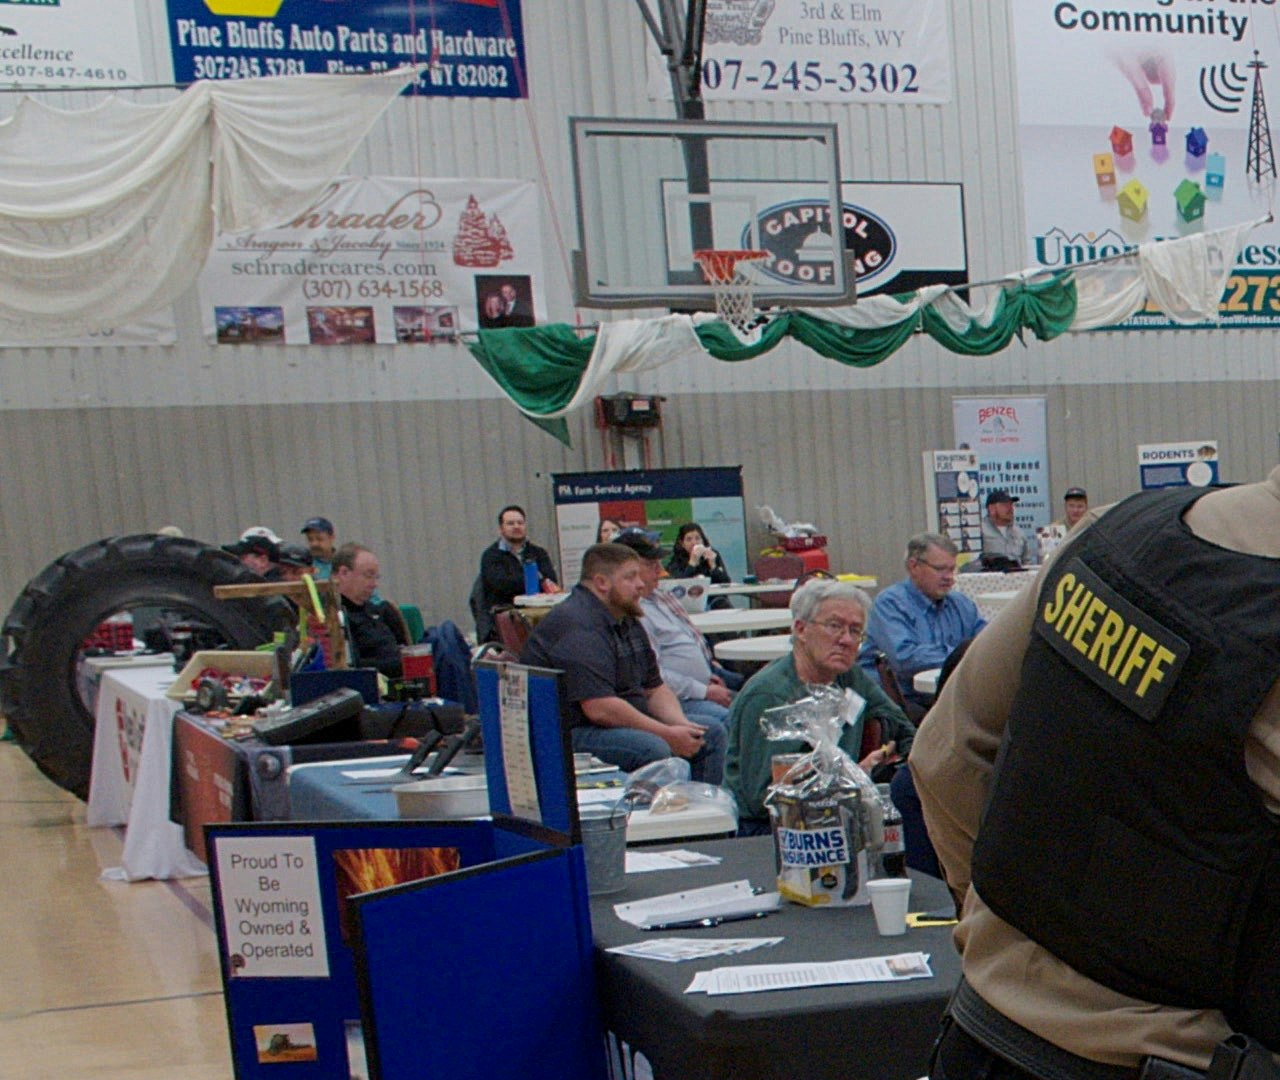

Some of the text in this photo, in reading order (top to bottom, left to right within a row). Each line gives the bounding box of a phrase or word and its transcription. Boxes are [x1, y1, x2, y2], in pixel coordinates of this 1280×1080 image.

[801, 2, 882, 22] 3rd & Elm
[1053, 2, 1249, 42] Community
[176, 19, 517, 59] Pine Bluffs Auto Parts and Hardware
[779, 28, 905, 48] Pine Bluffs, WY
[0, 44, 74, 61] cellence
[430, 65, 455, 86] WY
[457, 64, 510, 87] 82082
[700, 57, 920, 94] 07-245-3302
[765, 207, 869, 240] CAPIOL
[231, 257, 437, 278] schradercares.com
[302, 278, 444, 301] (307) 634-1568
[978, 406, 1020, 425] BENZEL
[1141, 449, 1196, 461] RODENTS
[979, 460, 1041, 472] mily Owned
[594, 484, 623, 497] Service
[624, 483, 654, 497] Agency
[1043, 572, 1177, 699] SHERIFF
[788, 829, 845, 851] BURNS
[230, 853, 305, 870] Proud To
[258, 876, 281, 892] Be
[234, 898, 310, 918] Wyoming
[239, 919, 312, 936] Owned &
[240, 942, 314, 961] Operated
